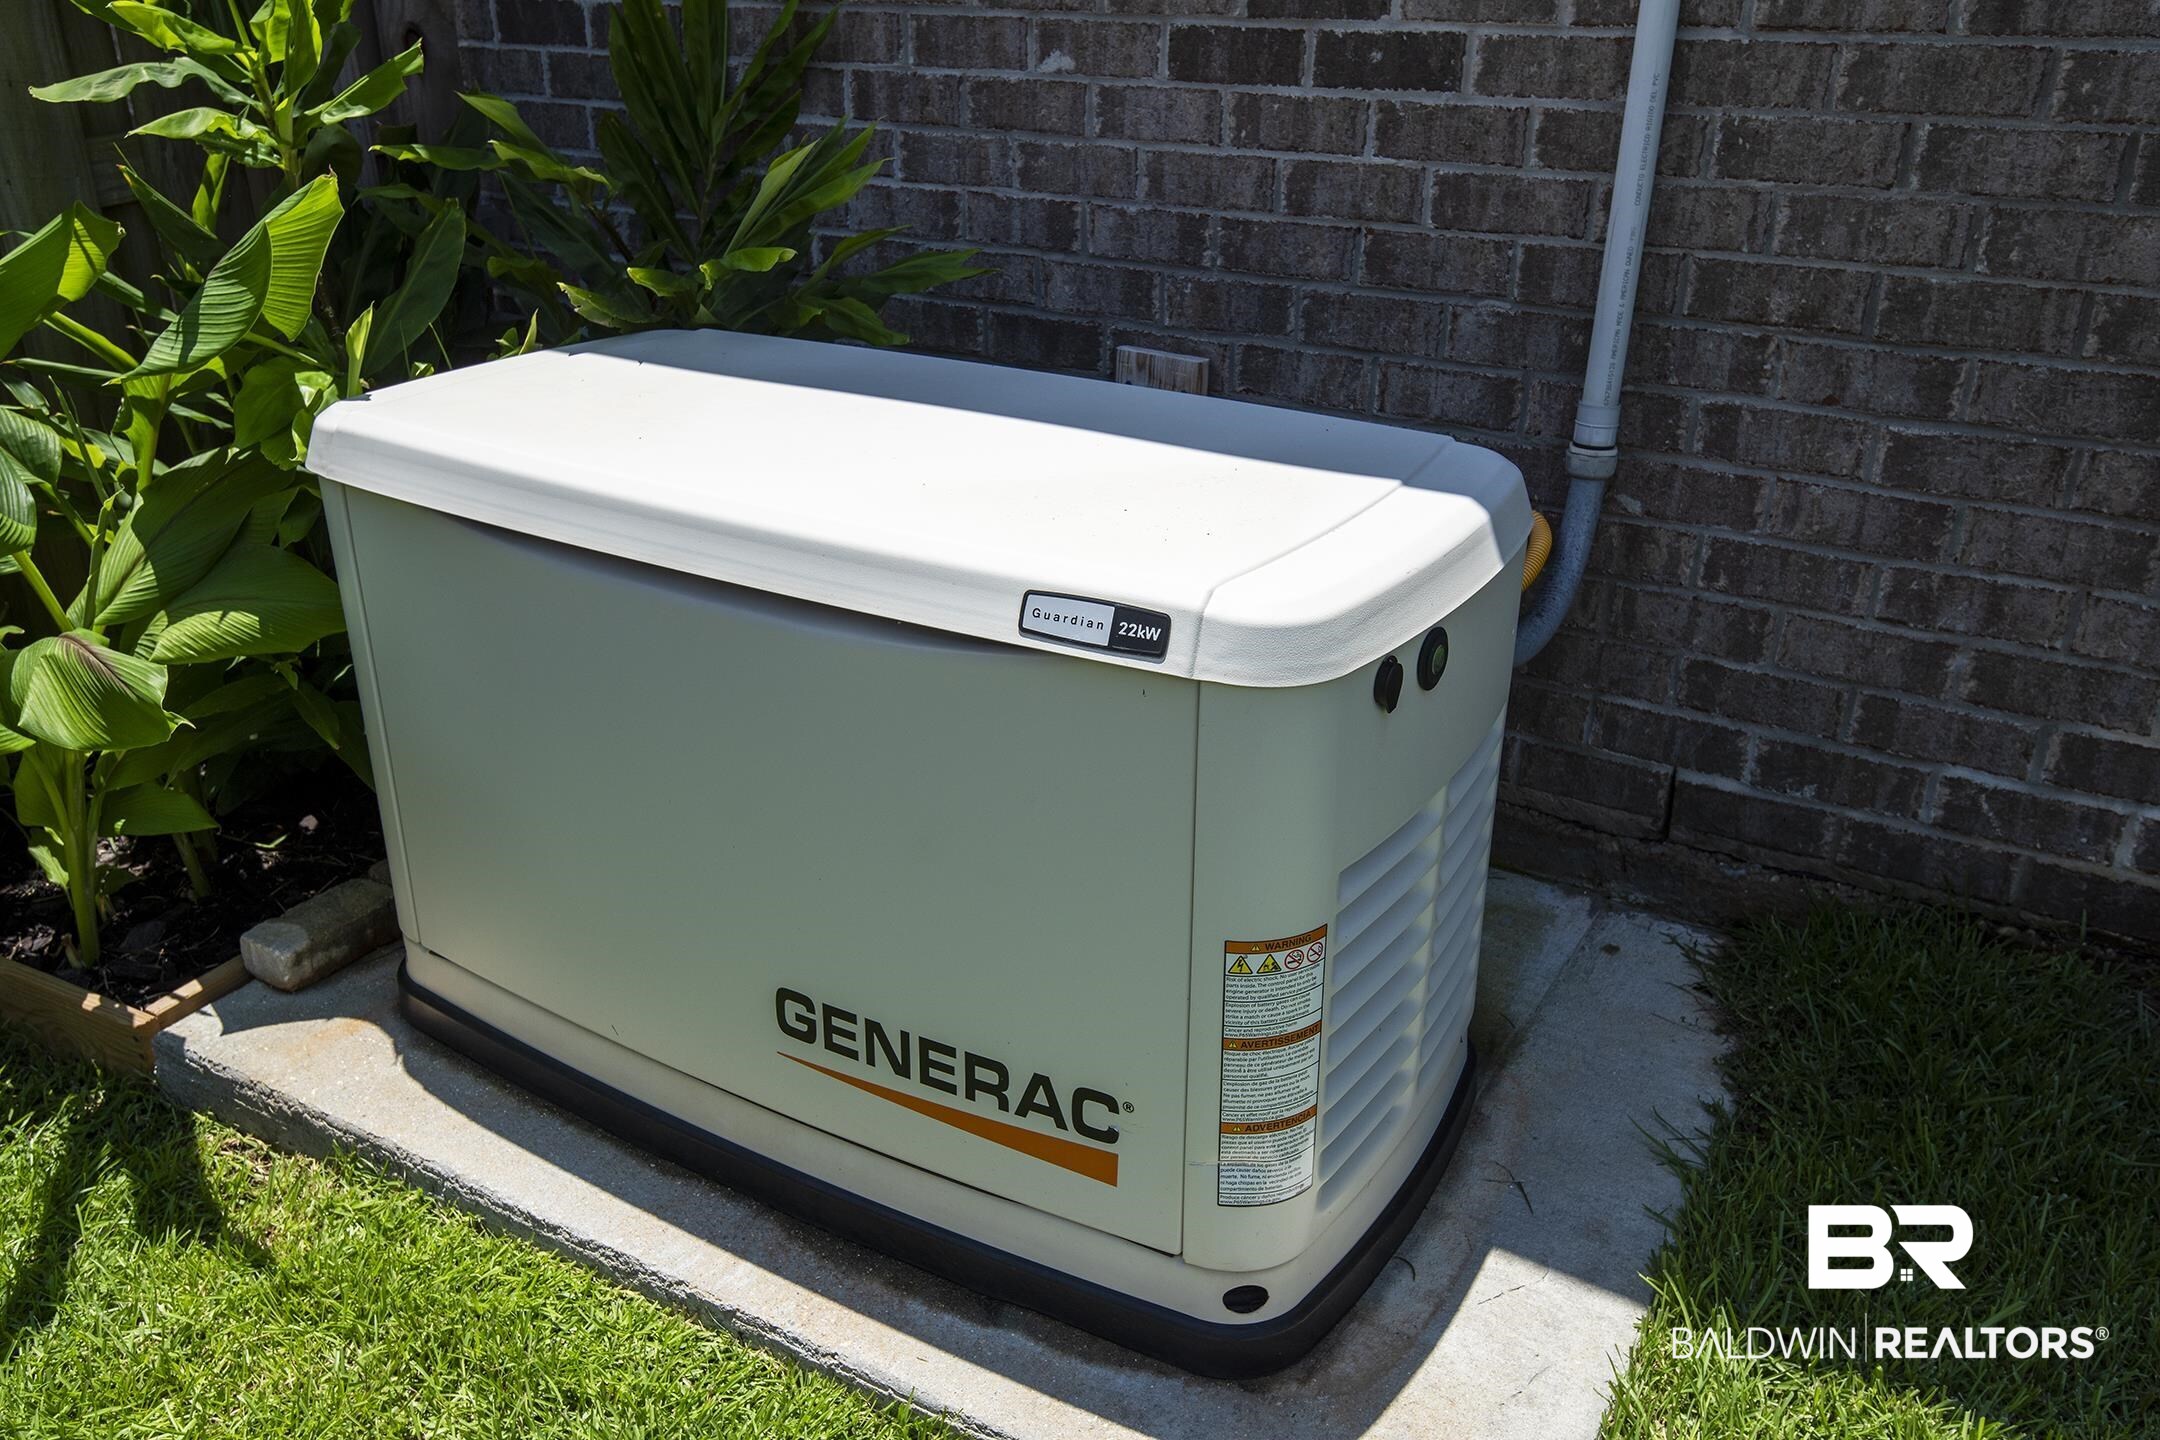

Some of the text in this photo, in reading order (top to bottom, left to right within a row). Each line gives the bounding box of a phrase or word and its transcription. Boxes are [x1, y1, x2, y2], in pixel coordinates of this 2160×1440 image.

[1031, 607, 1104, 631] Guardian
[1118, 621, 1162, 642] 22kW
[1265, 935, 1312, 951] WARNING
[1286, 977, 1298, 985] panel
[1240, 1024, 1319, 1048] AVERTISSEMENT
[1245, 1110, 1311, 1132] ADVERTENCIA
